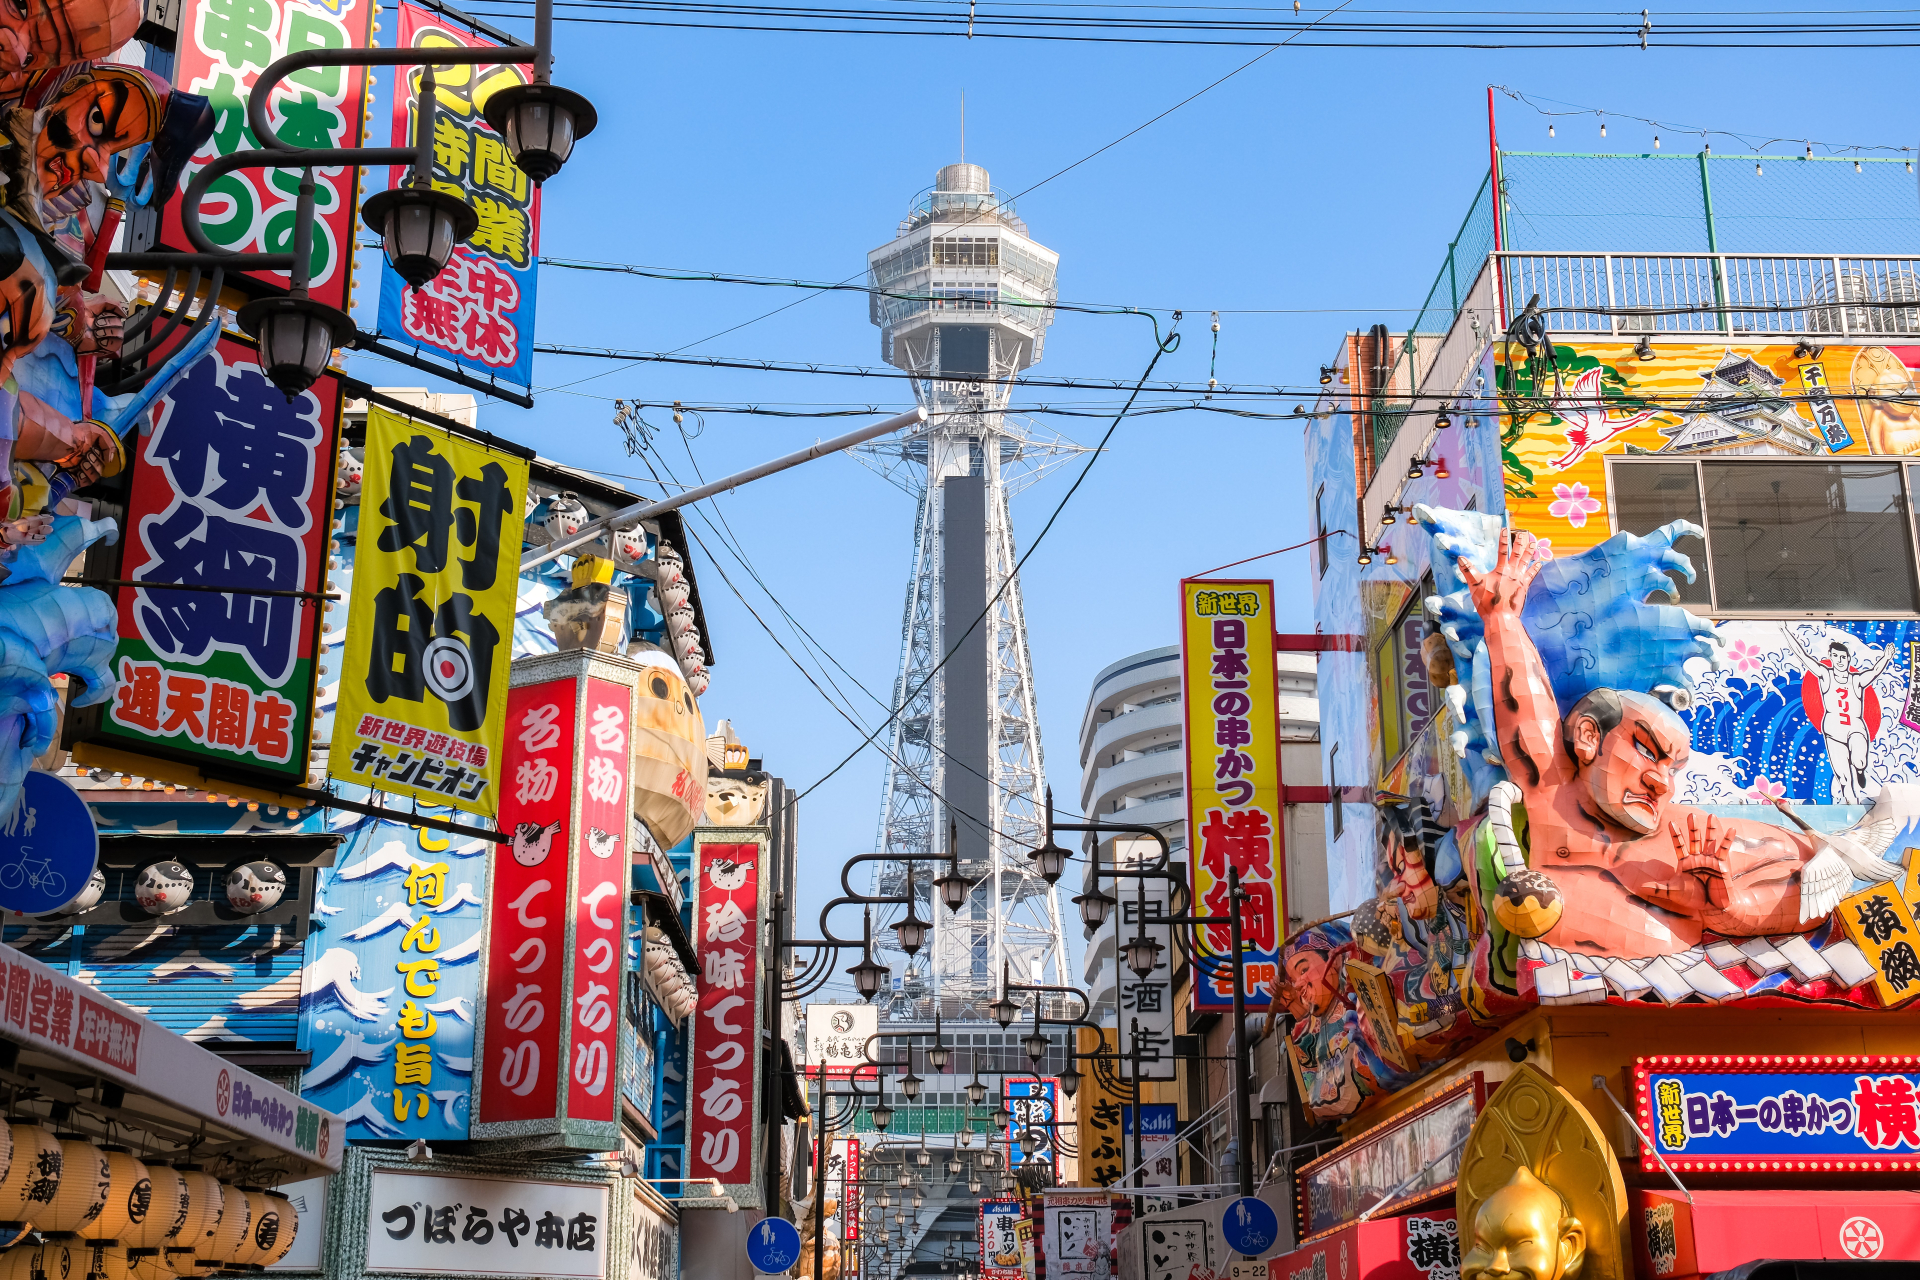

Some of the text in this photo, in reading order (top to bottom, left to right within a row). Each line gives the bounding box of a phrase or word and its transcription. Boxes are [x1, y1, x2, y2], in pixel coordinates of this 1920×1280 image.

[410, 293, 513, 360] 無休
[933, 381, 996, 393] HITACHI
[140, 353, 317, 680] 横綱
[365, 434, 514, 732] 射的
[1197, 592, 1259, 617] 新世界
[114, 663, 293, 761] 通天閣店
[1211, 619, 1254, 806] 日本一の串かつ
[1835, 686, 1851, 726] グリコ
[352, 744, 489, 802] チャンピオン
[357, 715, 490, 768] 新世界遊技場
[515, 702, 561, 805] 名物
[587, 703, 627, 806] 名物
[1201, 809, 1276, 953] 横綱
[393, 799, 451, 1122] て何んでも旨い
[499, 878, 552, 1097] てっちり
[575, 880, 619, 1097] てっちり
[81, 1003, 136, 1068] 年中無休
[701, 899, 750, 1173] 珍味てっちり
[1090, 1098, 1122, 1190] ぎふや
[1657, 1081, 1686, 1147] 新世界
[1686, 1093, 1852, 1135] 日本一の串かつ
[1854, 1078, 1920, 1147] 横
[1132, 1156, 1173, 1178] 関
[381, 1200, 598, 1253] づぼらや本店
[991, 1204, 1011, 1213] Asahi
[1410, 1233, 1461, 1268] 横
